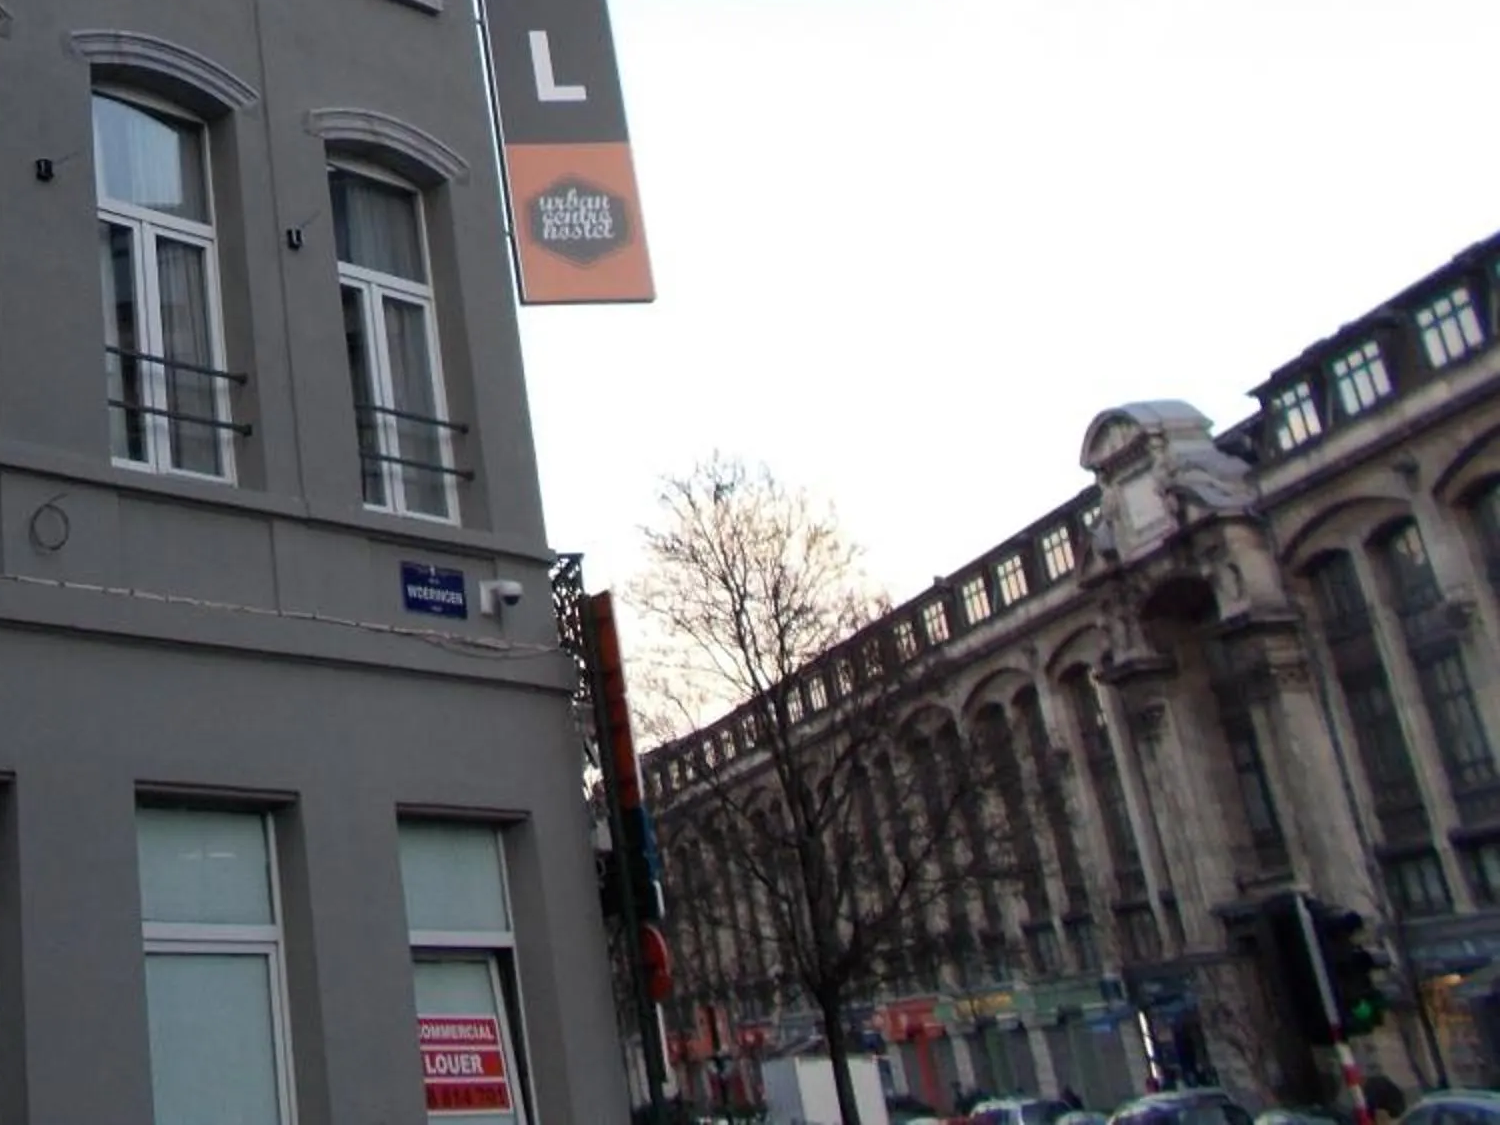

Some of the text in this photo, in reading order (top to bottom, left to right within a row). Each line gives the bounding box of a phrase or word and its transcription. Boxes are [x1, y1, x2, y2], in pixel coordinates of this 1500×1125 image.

[539, 187, 611, 211] urban
[543, 220, 616, 240] hostel
[419, 1024, 495, 1040] OMMERCIAL
[424, 1053, 485, 1075] LOUER
